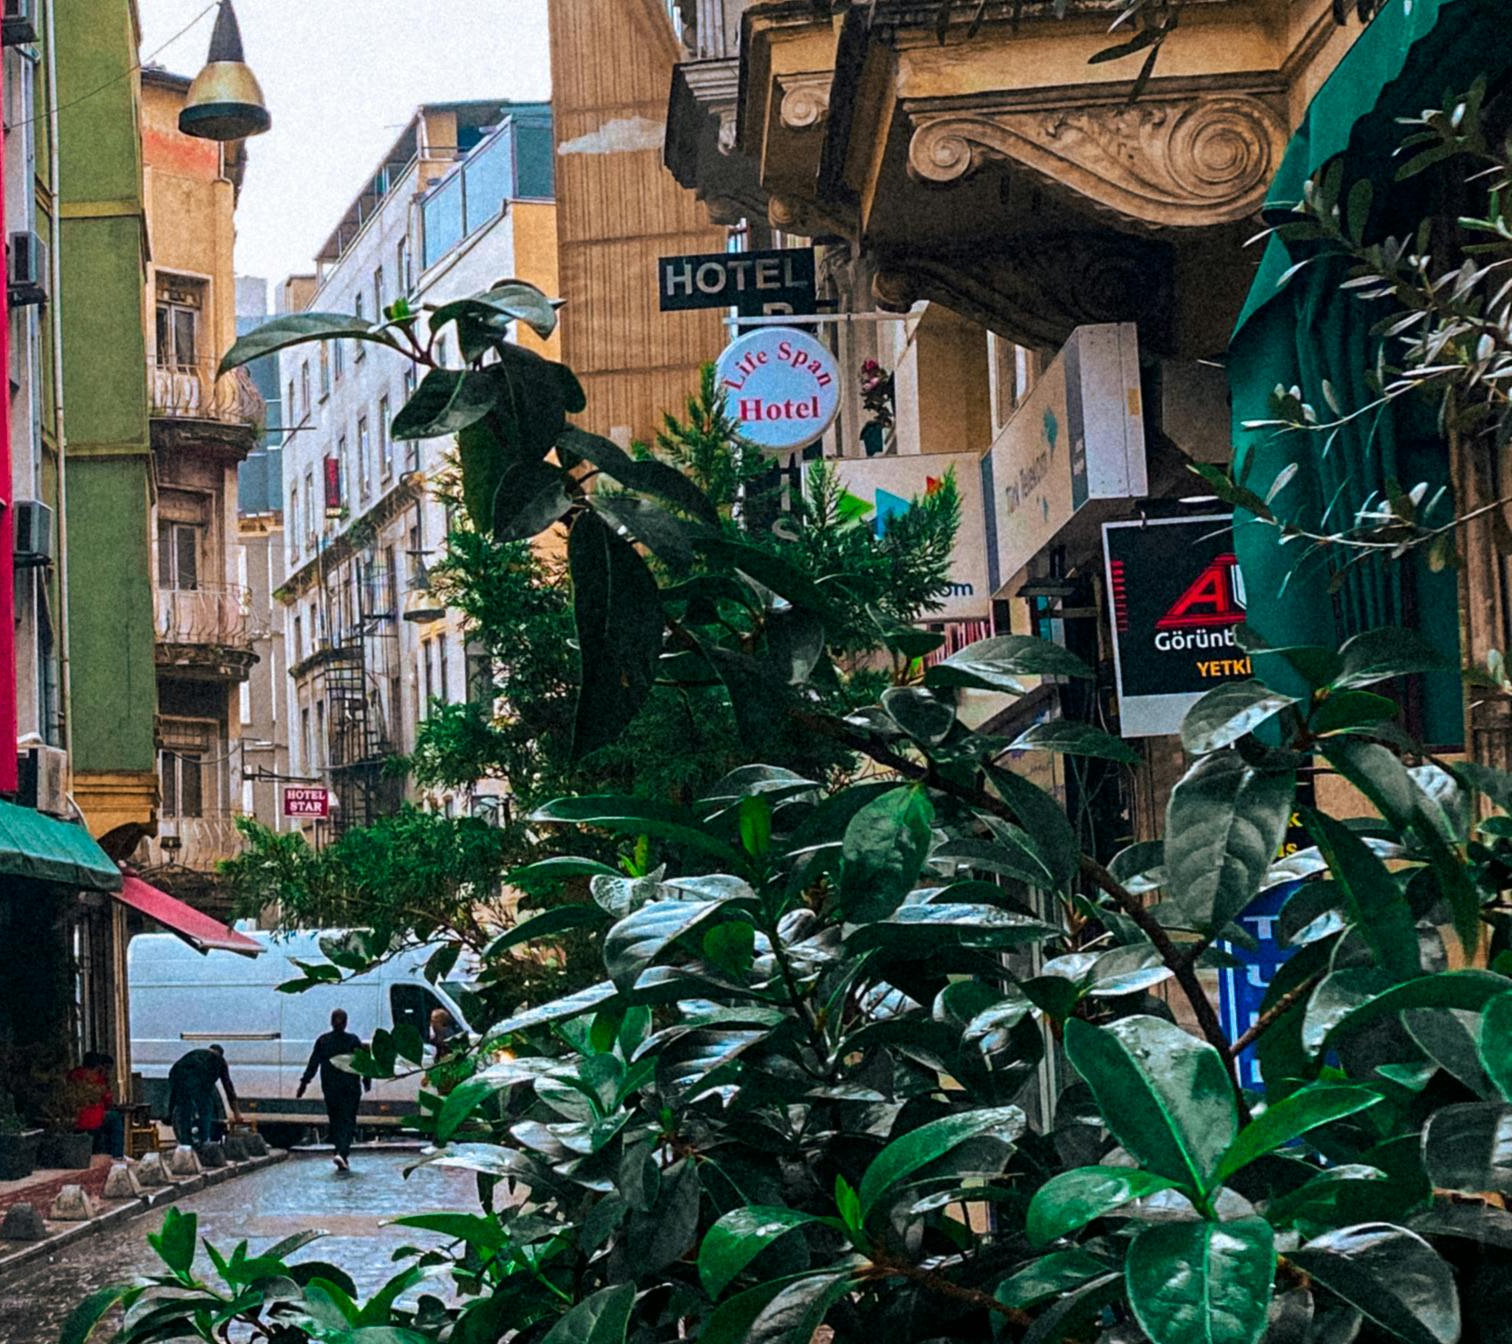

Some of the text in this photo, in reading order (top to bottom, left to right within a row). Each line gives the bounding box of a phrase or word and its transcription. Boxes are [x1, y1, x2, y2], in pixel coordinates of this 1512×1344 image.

[665, 257, 809, 296] HOTEL
[723, 341, 833, 391] Life Span
[739, 395, 821, 422] Hotel
[1154, 629, 1235, 651] Görünt
[1196, 656, 1252, 677] YETKİ
[287, 789, 326, 800] HOTEL
[289, 800, 323, 812] STAR
